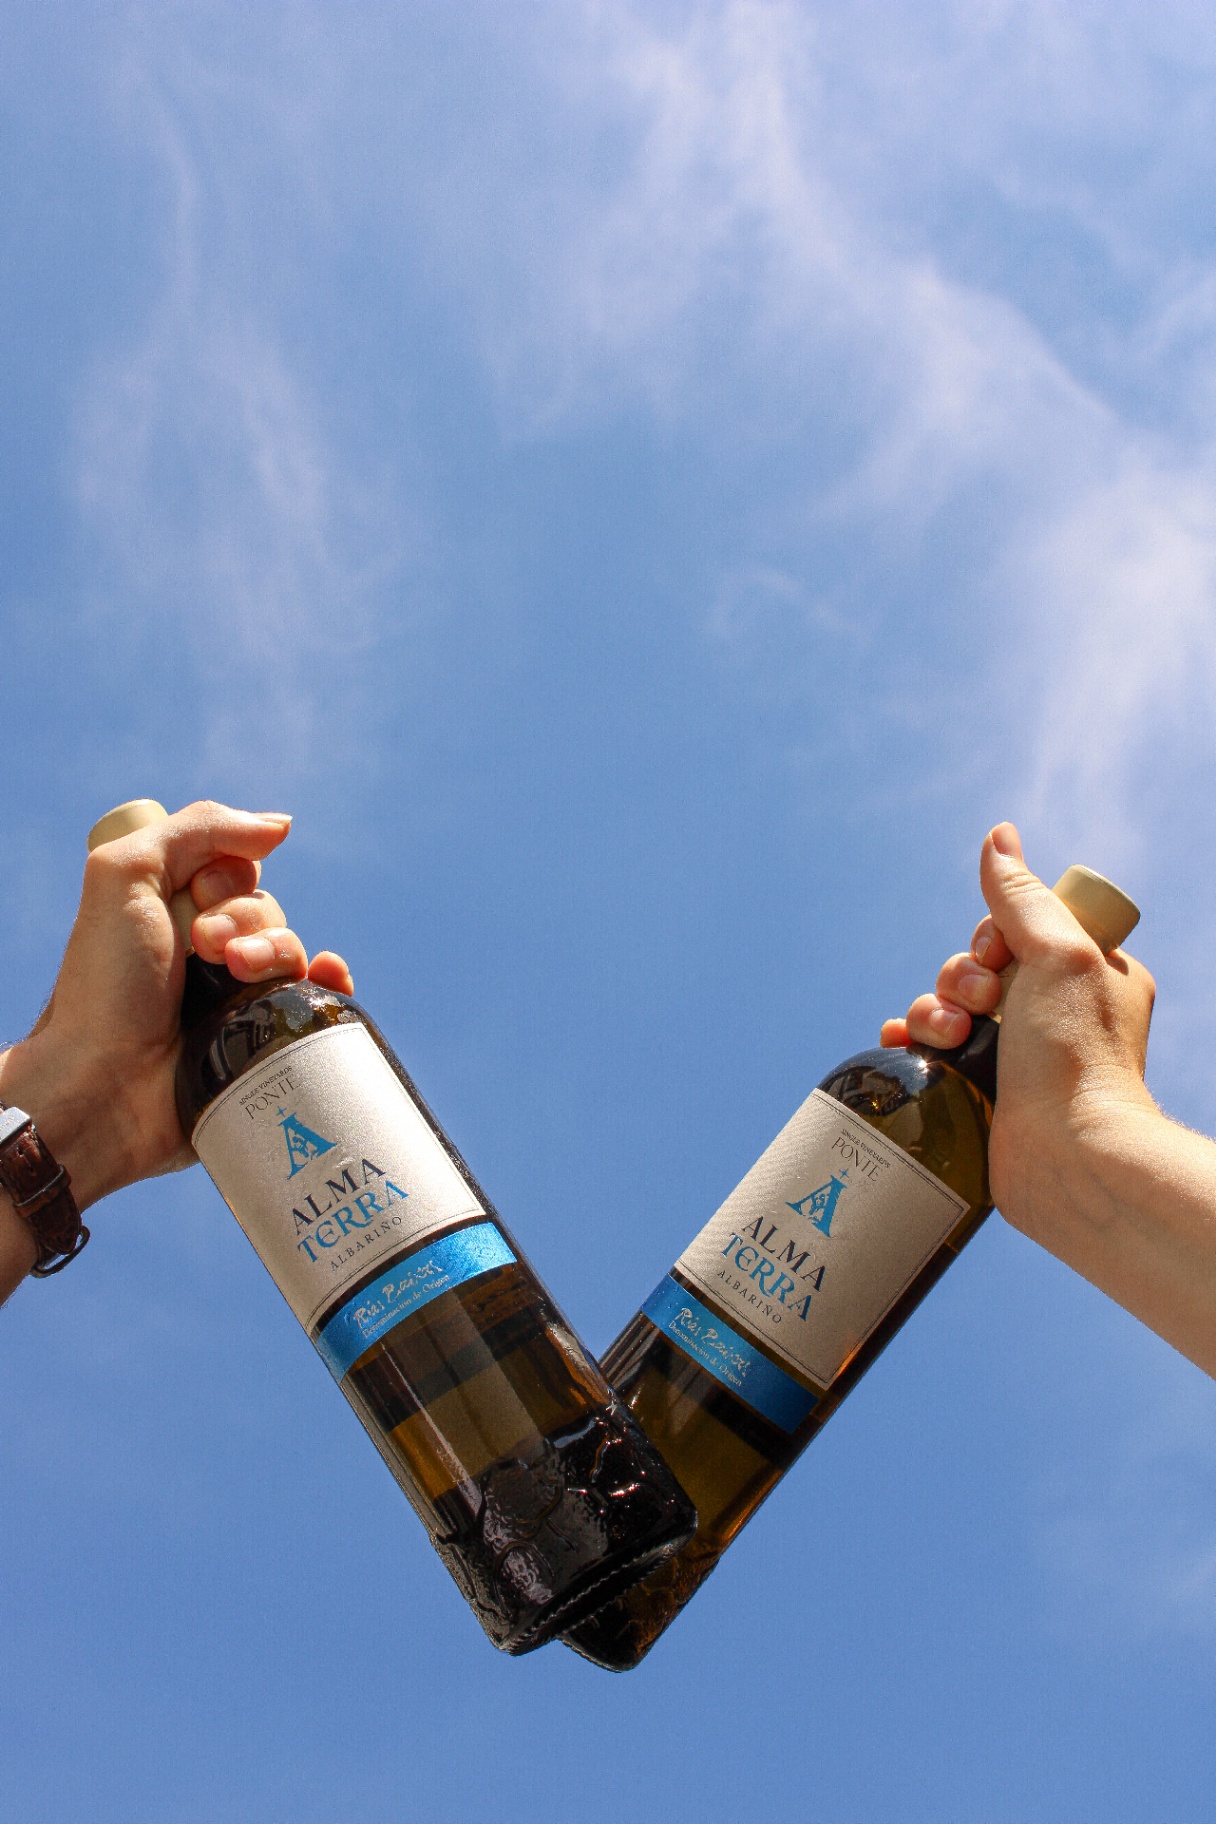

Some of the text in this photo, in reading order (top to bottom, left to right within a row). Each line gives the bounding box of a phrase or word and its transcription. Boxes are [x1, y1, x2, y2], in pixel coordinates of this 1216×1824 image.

[245, 1074, 300, 1120] PONTE
[259, 1065, 293, 1089] VINEYARDS
[831, 1137, 881, 1182] PONTE
[292, 1159, 386, 1236] ALMA
[297, 1180, 409, 1263] TERRA
[330, 1216, 402, 1271] ALBARIÑO
[742, 1215, 826, 1292] ALMA
[422, 1275, 450, 1293] Origen
[717, 1270, 782, 1324] ALBARIÑO
[721, 1232, 812, 1322] TERRA
[719, 1364, 742, 1387] Origen
